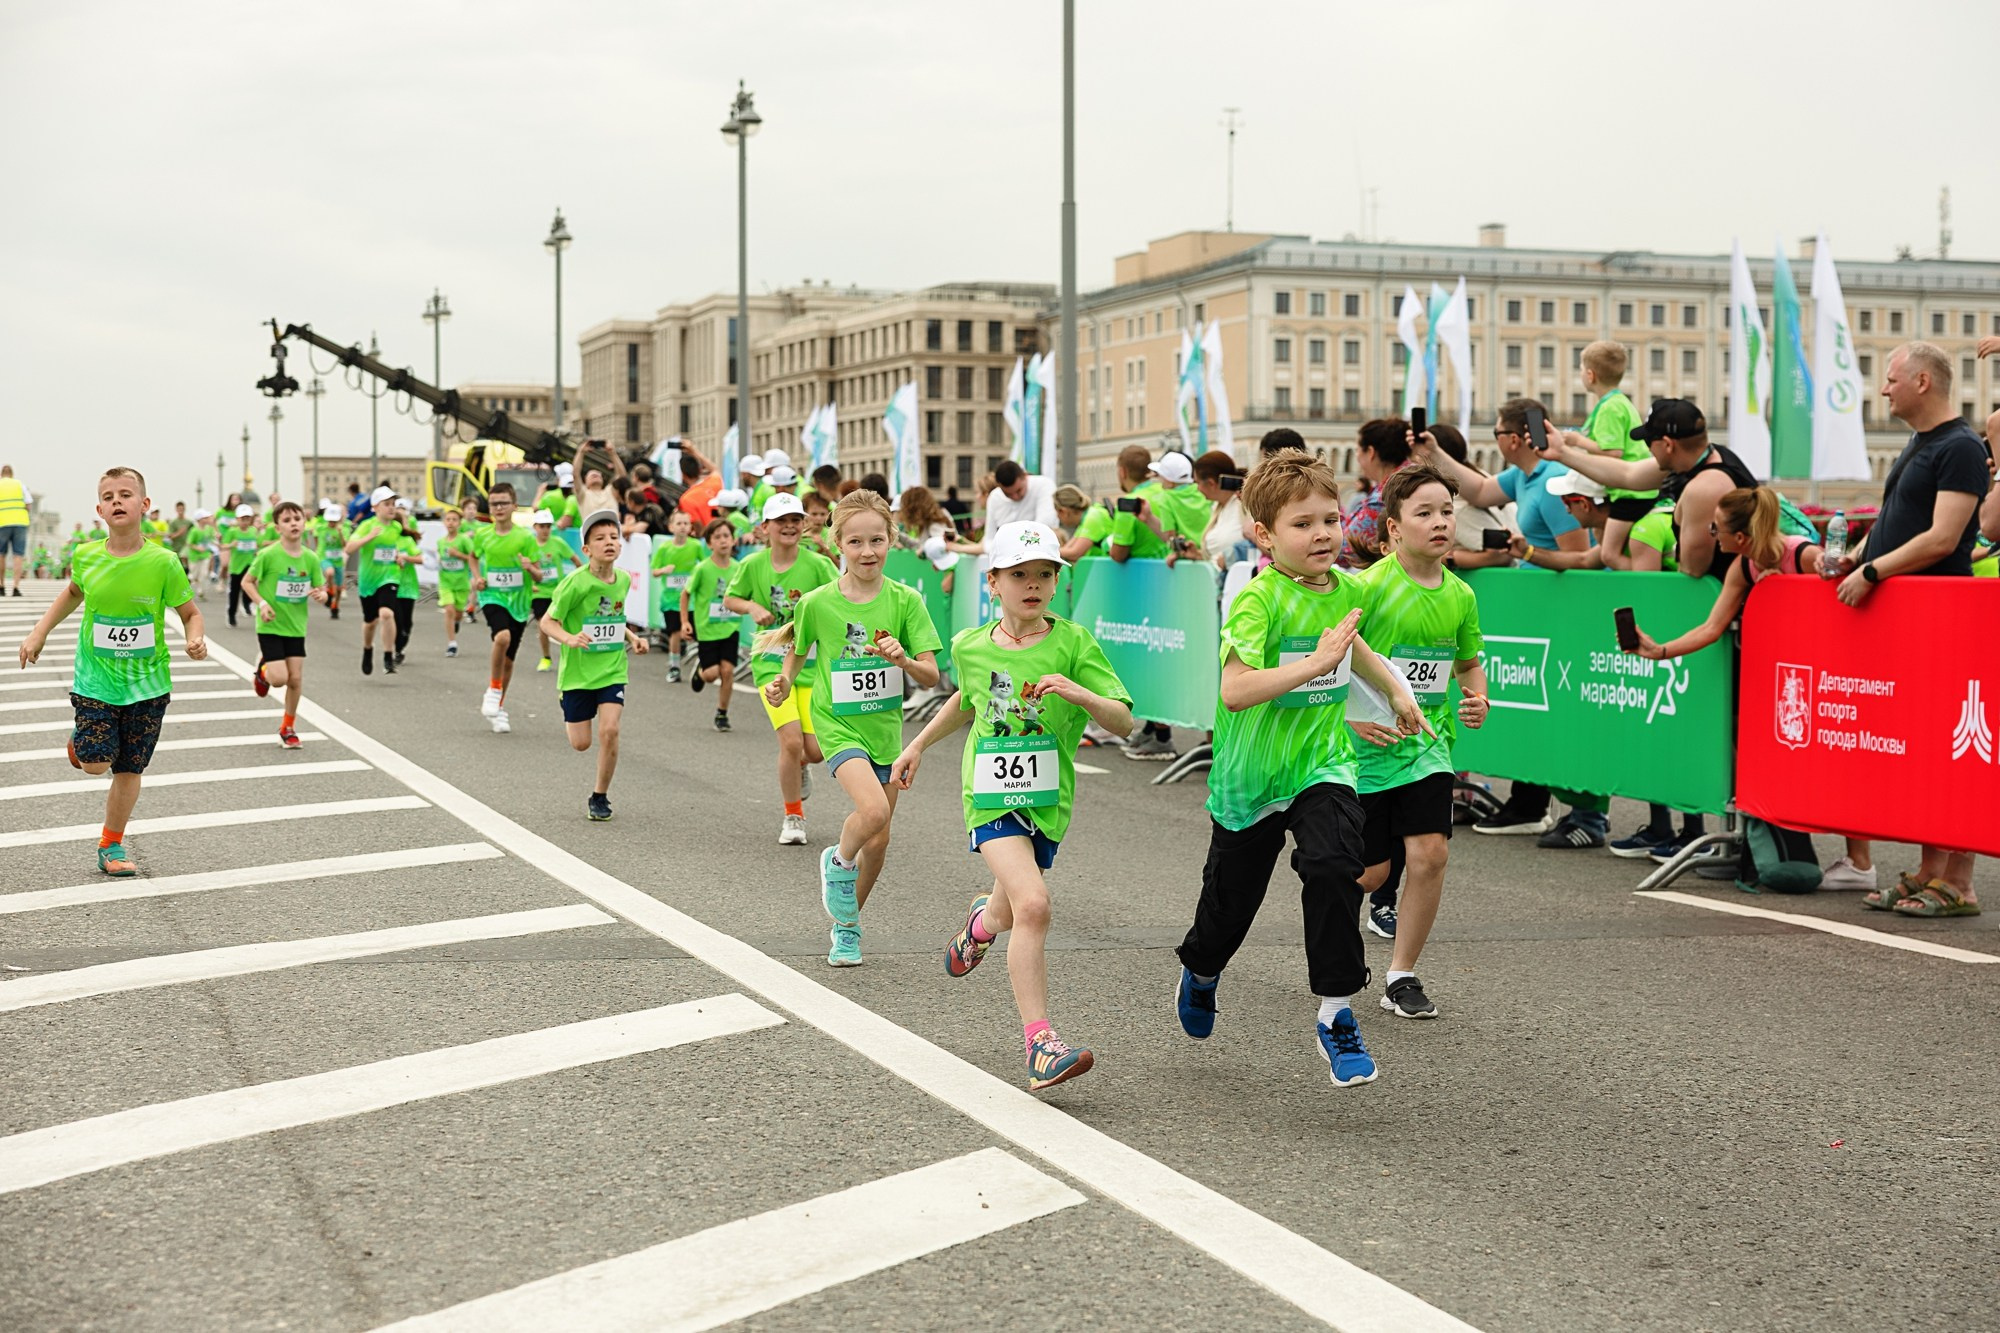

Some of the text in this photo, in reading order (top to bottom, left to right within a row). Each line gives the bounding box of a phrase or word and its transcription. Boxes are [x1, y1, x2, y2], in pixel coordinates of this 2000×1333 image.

[496, 574, 513, 583] 431
[287, 583, 305, 593] 302
[108, 628, 139, 642] 469
[594, 625, 615, 637] 310
[1095, 615, 1185, 653] #создаваябудущее
[852, 670, 886, 691] 581
[1406, 662, 1439, 682] 284
[1490, 656, 1536, 690] Прайм
[1818, 671, 1896, 698] Департамент
[864, 691, 879, 699] ВЕРА
[1308, 692, 1333, 704] 600м
[1580, 677, 1647, 713] марафон
[861, 702, 883, 712] 600м
[1818, 701, 1858, 724] спорта
[1817, 728, 1907, 755] города Москвы
[993, 754, 1037, 779] 361
[1004, 780, 1032, 789] МАРИЯ
[1003, 795, 1034, 806] 600м
